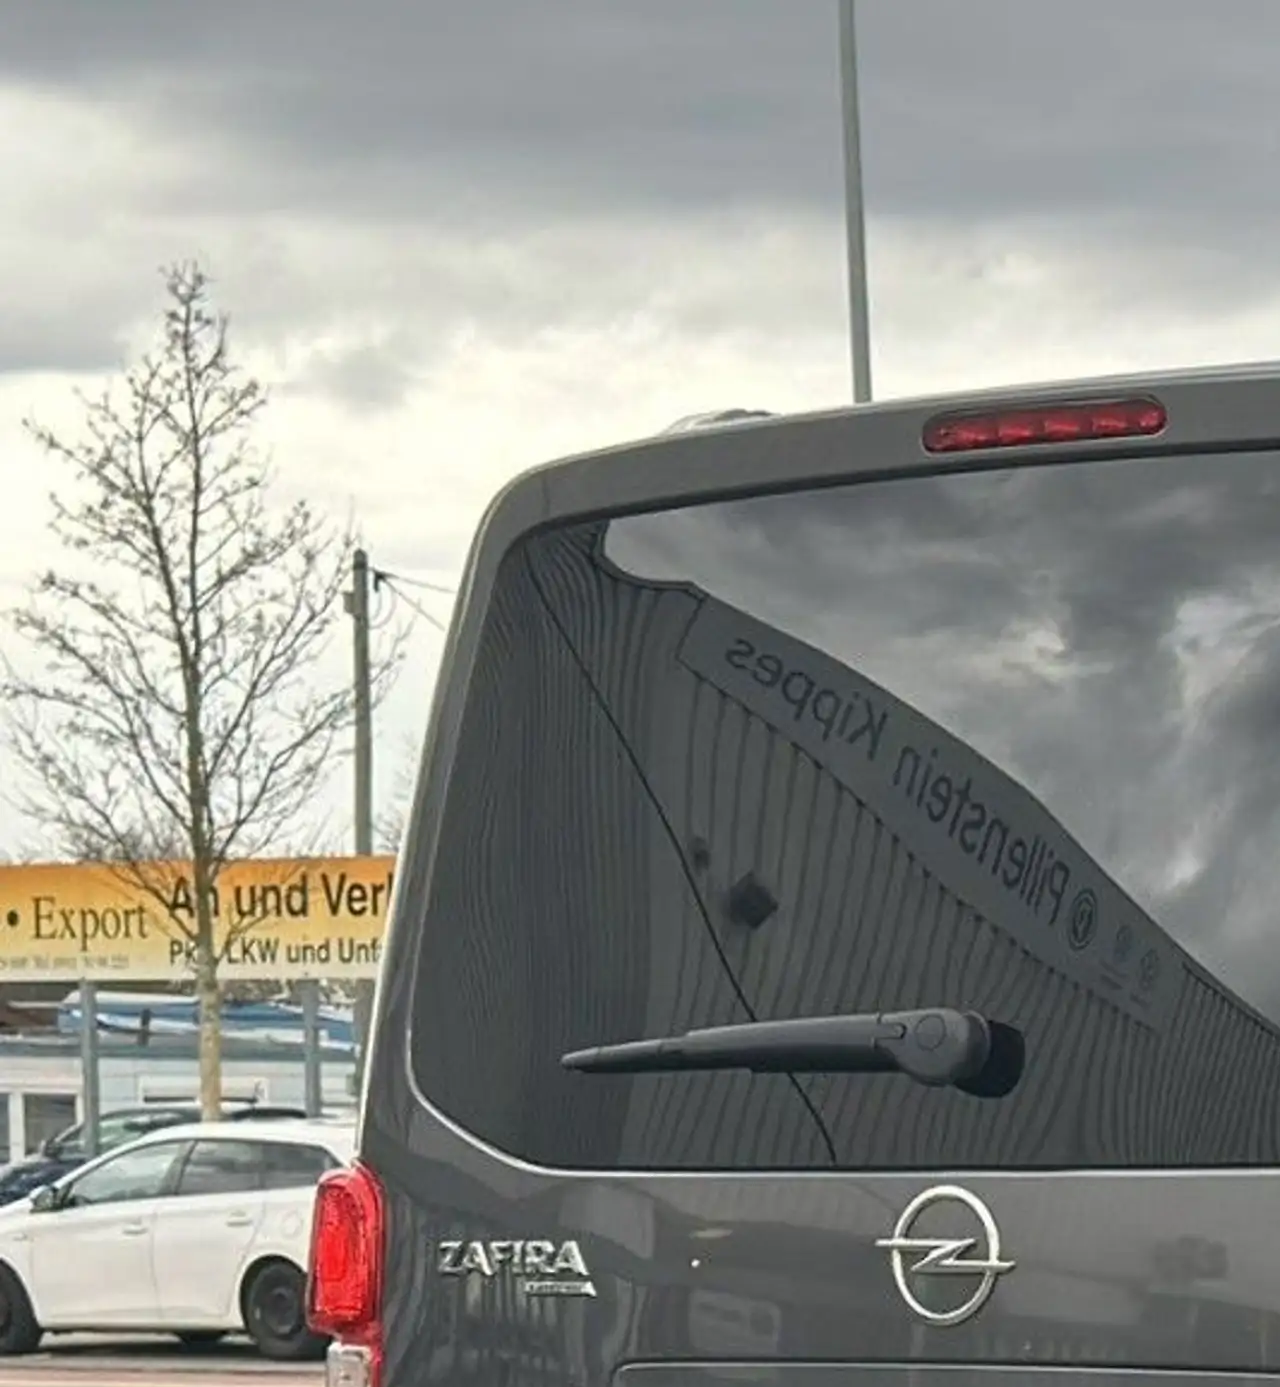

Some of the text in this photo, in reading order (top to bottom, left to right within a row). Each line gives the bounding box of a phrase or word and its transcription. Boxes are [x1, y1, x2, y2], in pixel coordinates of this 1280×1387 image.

[234, 873, 308, 918] und
[31, 896, 148, 952] Export
[287, 937, 330, 964] und
[437, 1240, 590, 1276] ZAFIRA
